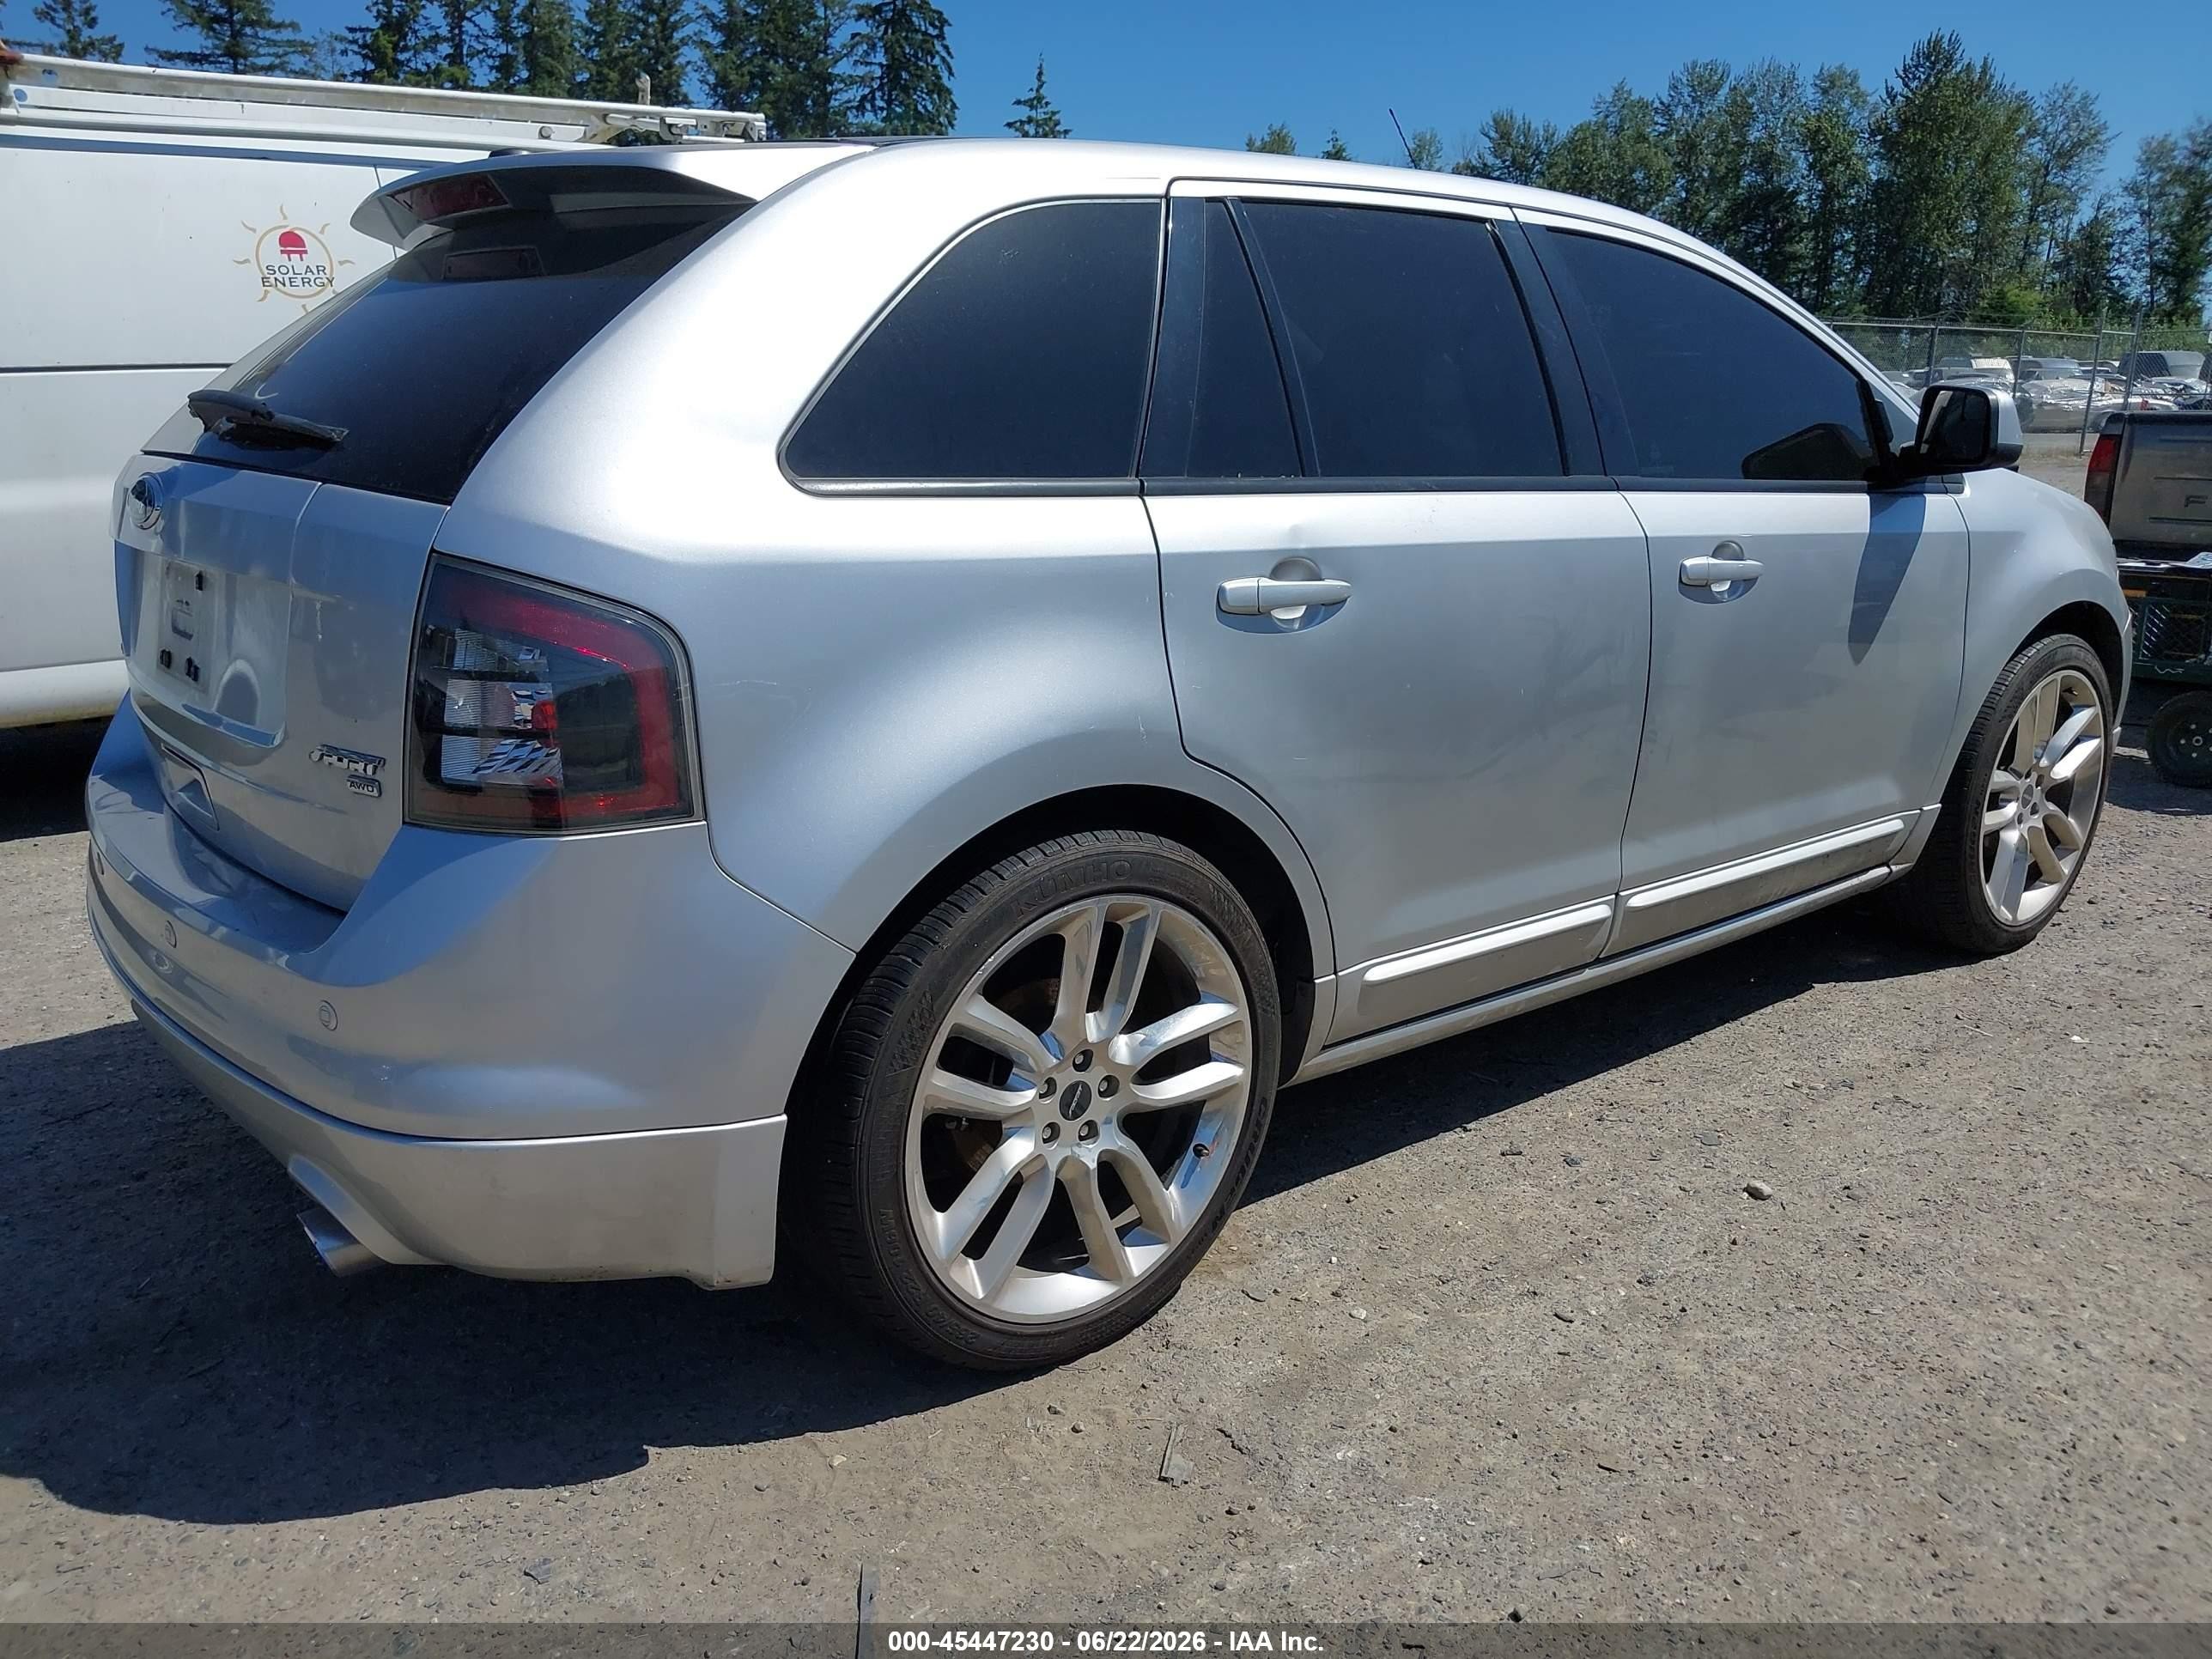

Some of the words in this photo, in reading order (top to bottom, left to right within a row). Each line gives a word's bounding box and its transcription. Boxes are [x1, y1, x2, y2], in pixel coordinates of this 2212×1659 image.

[265, 264, 327, 276] SOLAR
[261, 276, 335, 288] ENERGY
[349, 781, 375, 793] AWD
[1011, 859, 1133, 920] KUMHO
